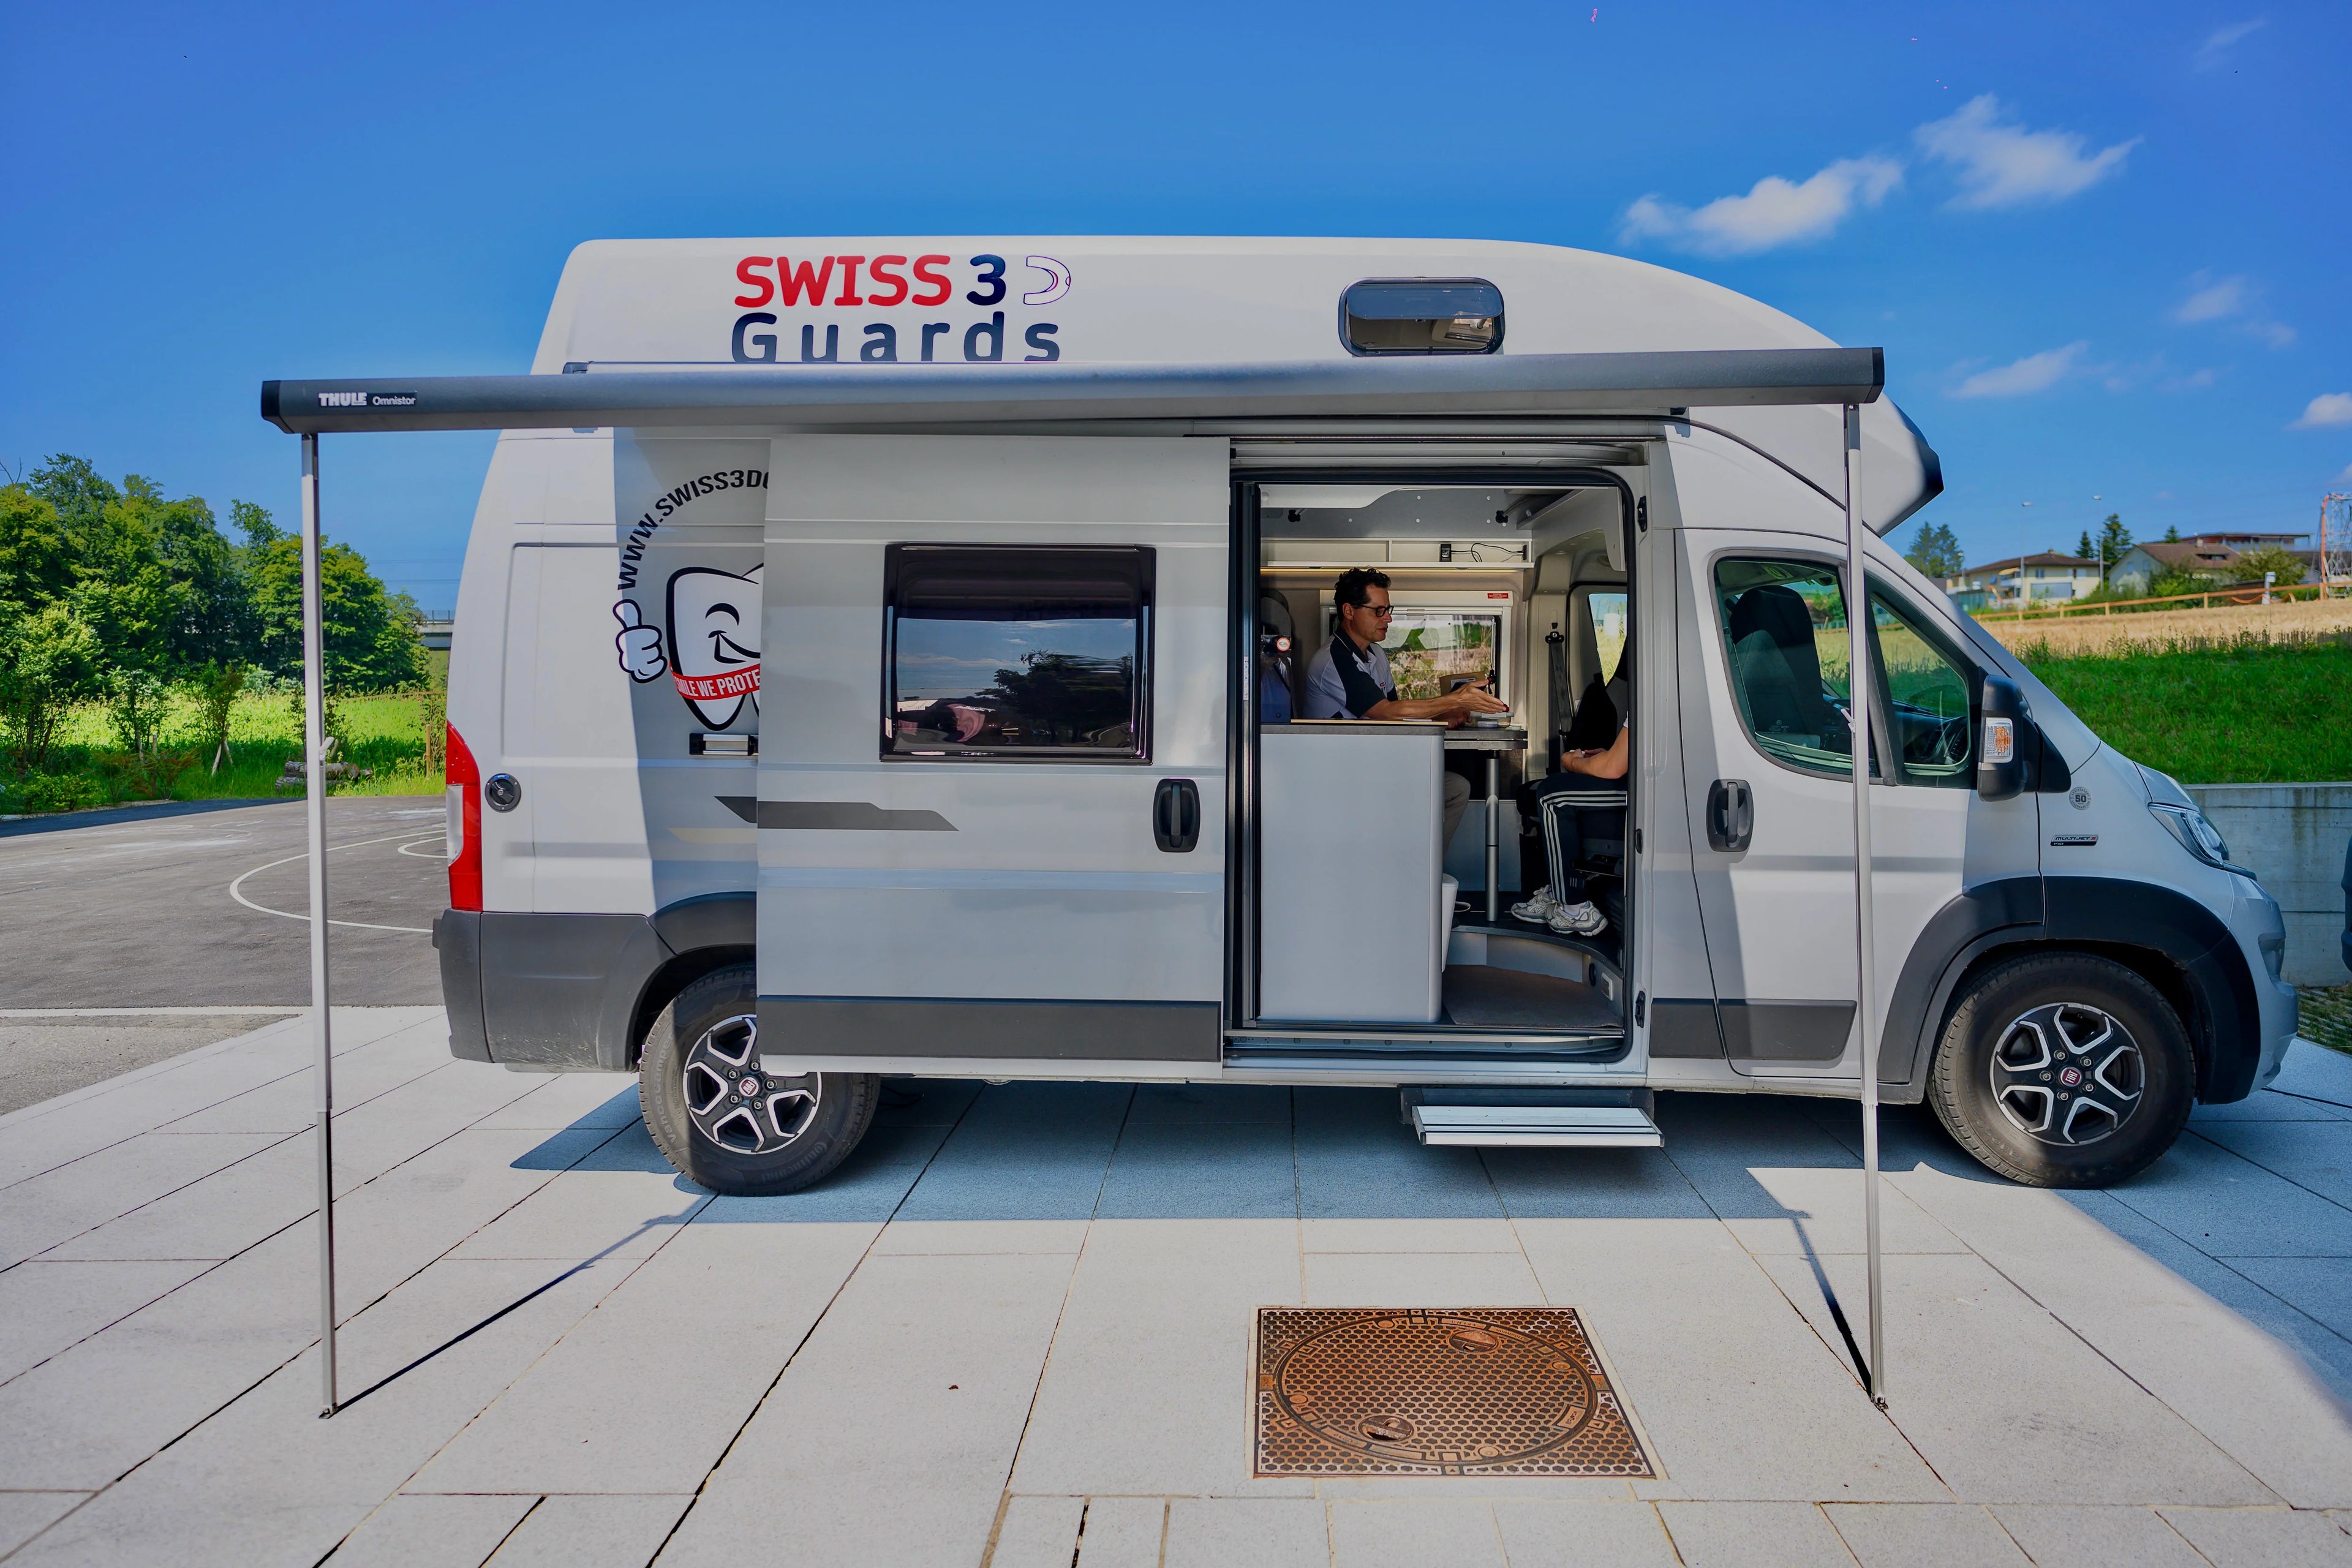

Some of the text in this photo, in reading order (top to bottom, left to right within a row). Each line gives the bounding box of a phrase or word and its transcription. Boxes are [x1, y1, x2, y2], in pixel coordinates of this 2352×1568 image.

[734, 255, 952, 307] SWISS
[731, 311, 1060, 361] Guards
[318, 392, 416, 407] THULE Omnistor
[617, 469, 769, 590] WWW.SWISS3D
[696, 679, 717, 697] WE
[2065, 1069, 2078, 1083] FIAT
